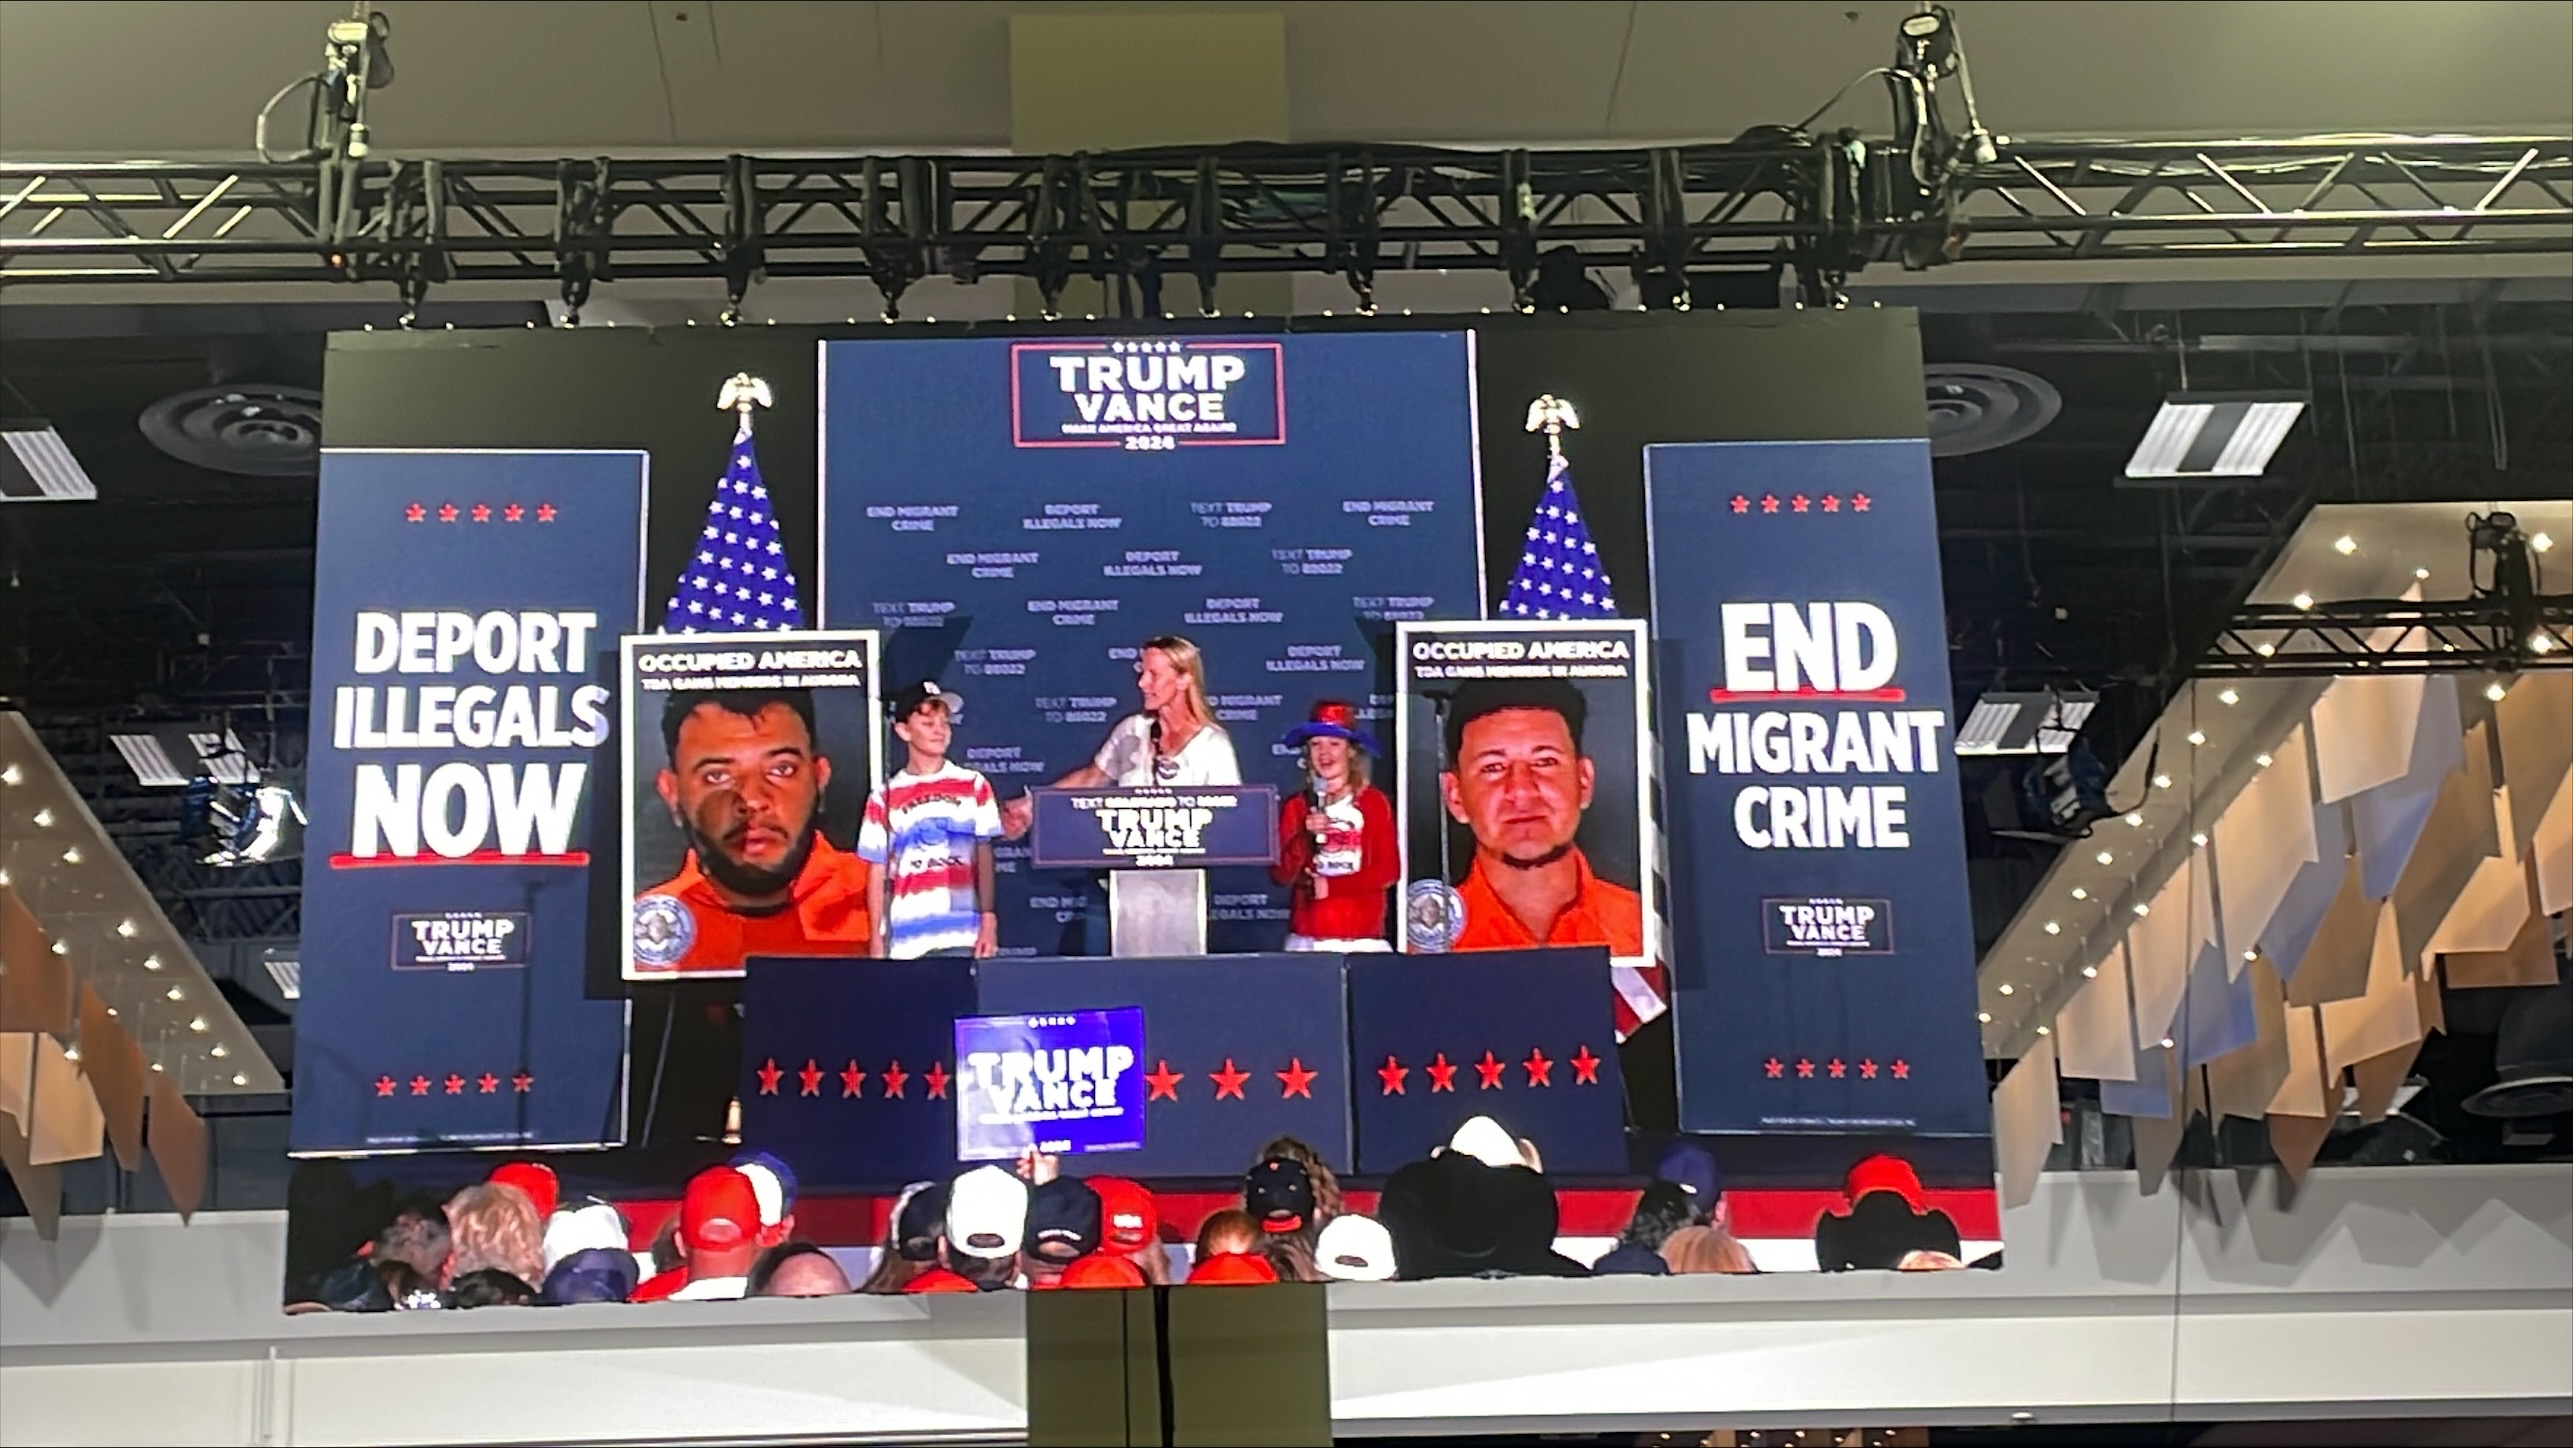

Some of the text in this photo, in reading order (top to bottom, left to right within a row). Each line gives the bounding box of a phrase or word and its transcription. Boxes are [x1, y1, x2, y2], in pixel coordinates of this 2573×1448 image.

[1050, 356, 1245, 392] TRUMP
[1074, 393, 1224, 421] VANCE
[1125, 436, 1176, 450] 2024
[866, 507, 895, 518] END
[1343, 501, 1371, 512] END
[947, 553, 975, 564] END
[1027, 601, 1056, 612] END
[355, 611, 597, 674] DEPORT
[1108, 648, 1137, 659] END
[1413, 640, 1630, 660] OCCUPIED AMERICA
[1721, 602, 1898, 691] END
[638, 650, 862, 673] OCCUPIED AMERICA
[334, 684, 610, 748] ILLEGALS
[1686, 711, 1945, 774] MIGRANT
[352, 762, 588, 858] NOW
[1096, 809, 1213, 833] TRUMP
[1734, 786, 1910, 848] CRIME
[1109, 829, 1201, 848] VANCE
[1778, 905, 1875, 925] TRUMP
[411, 919, 515, 940] TRUMP
[1791, 924, 1865, 940] VANCE
[422, 939, 502, 956] VANCE
[967, 1045, 1134, 1089] TRUMP
[987, 1078, 1117, 1114] VANCE
